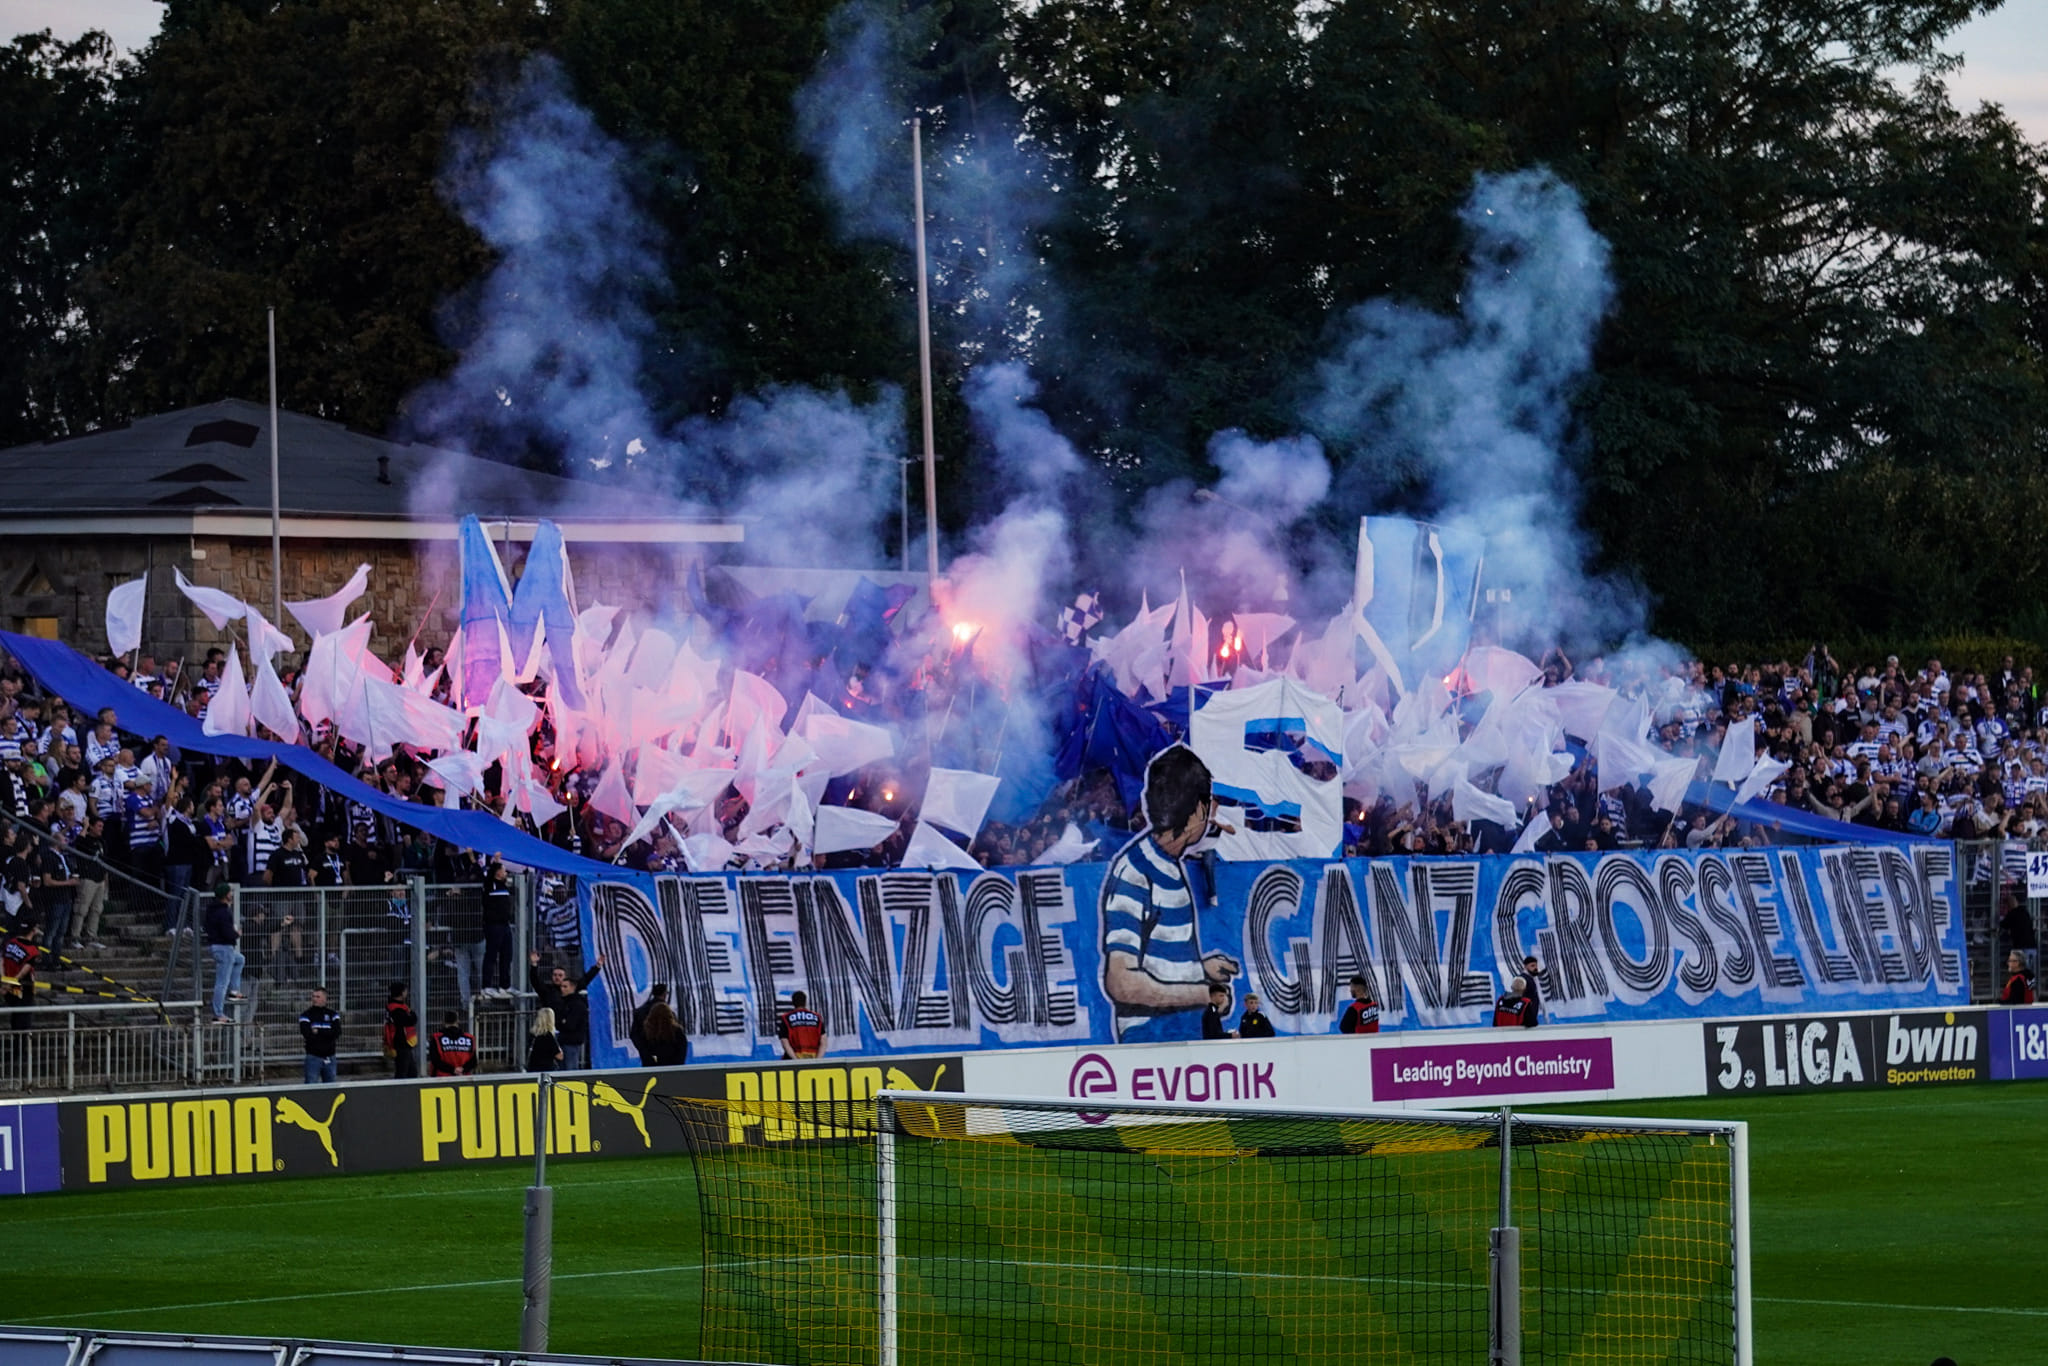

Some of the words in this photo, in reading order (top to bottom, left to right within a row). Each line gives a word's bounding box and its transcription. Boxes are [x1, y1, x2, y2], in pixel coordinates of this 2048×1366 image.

[590, 875, 747, 1042] DIE
[737, 870, 1078, 1038] EINZIGE
[1246, 862, 1494, 1016] GANZ
[1495, 853, 1806, 1003] GROSSE
[1780, 847, 1962, 986] LIEBE
[1393, 1060, 1453, 1087] Leading
[1456, 1055, 1512, 1085] Beyond
[1514, 1054, 1593, 1080] Chemistry
[1716, 1025, 1757, 1090] 3.
[1762, 1020, 1864, 1087] LIGA
[1886, 1012, 1978, 1064] bwin
[725, 1066, 883, 1145] PUMA
[1131, 1062, 1277, 1102] EVONIK
[1887, 1067, 1976, 1086] Sportwetten
[86, 1096, 274, 1183] PUMA
[420, 1080, 592, 1162] PUMA
